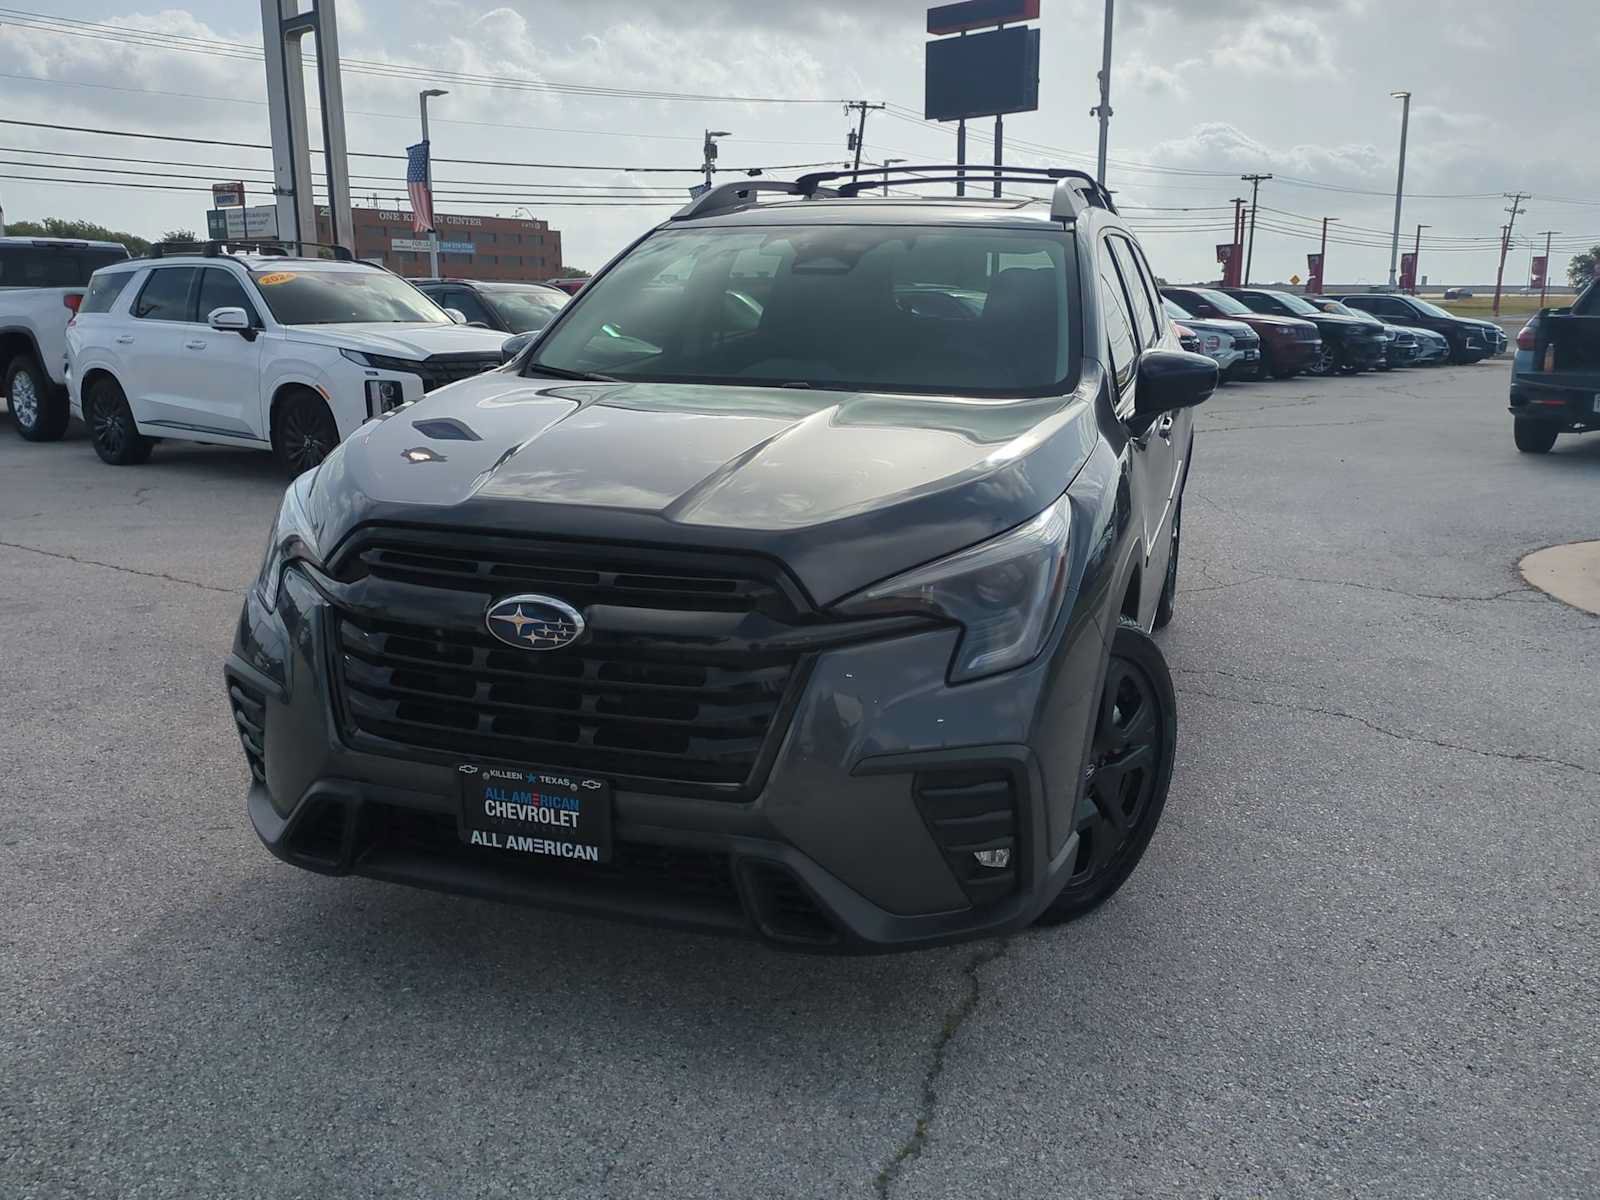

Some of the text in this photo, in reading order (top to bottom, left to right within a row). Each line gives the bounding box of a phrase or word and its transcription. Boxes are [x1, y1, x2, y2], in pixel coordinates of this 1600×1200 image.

[379, 211, 482, 226] ONE KIEN CENTER
[490, 769, 570, 786] KILLEEN TEXAS
[485, 787, 579, 811] ALL AMERICAN
[485, 800, 579, 828] CHEVROLET
[471, 830, 599, 861] ALL AMERICAN
